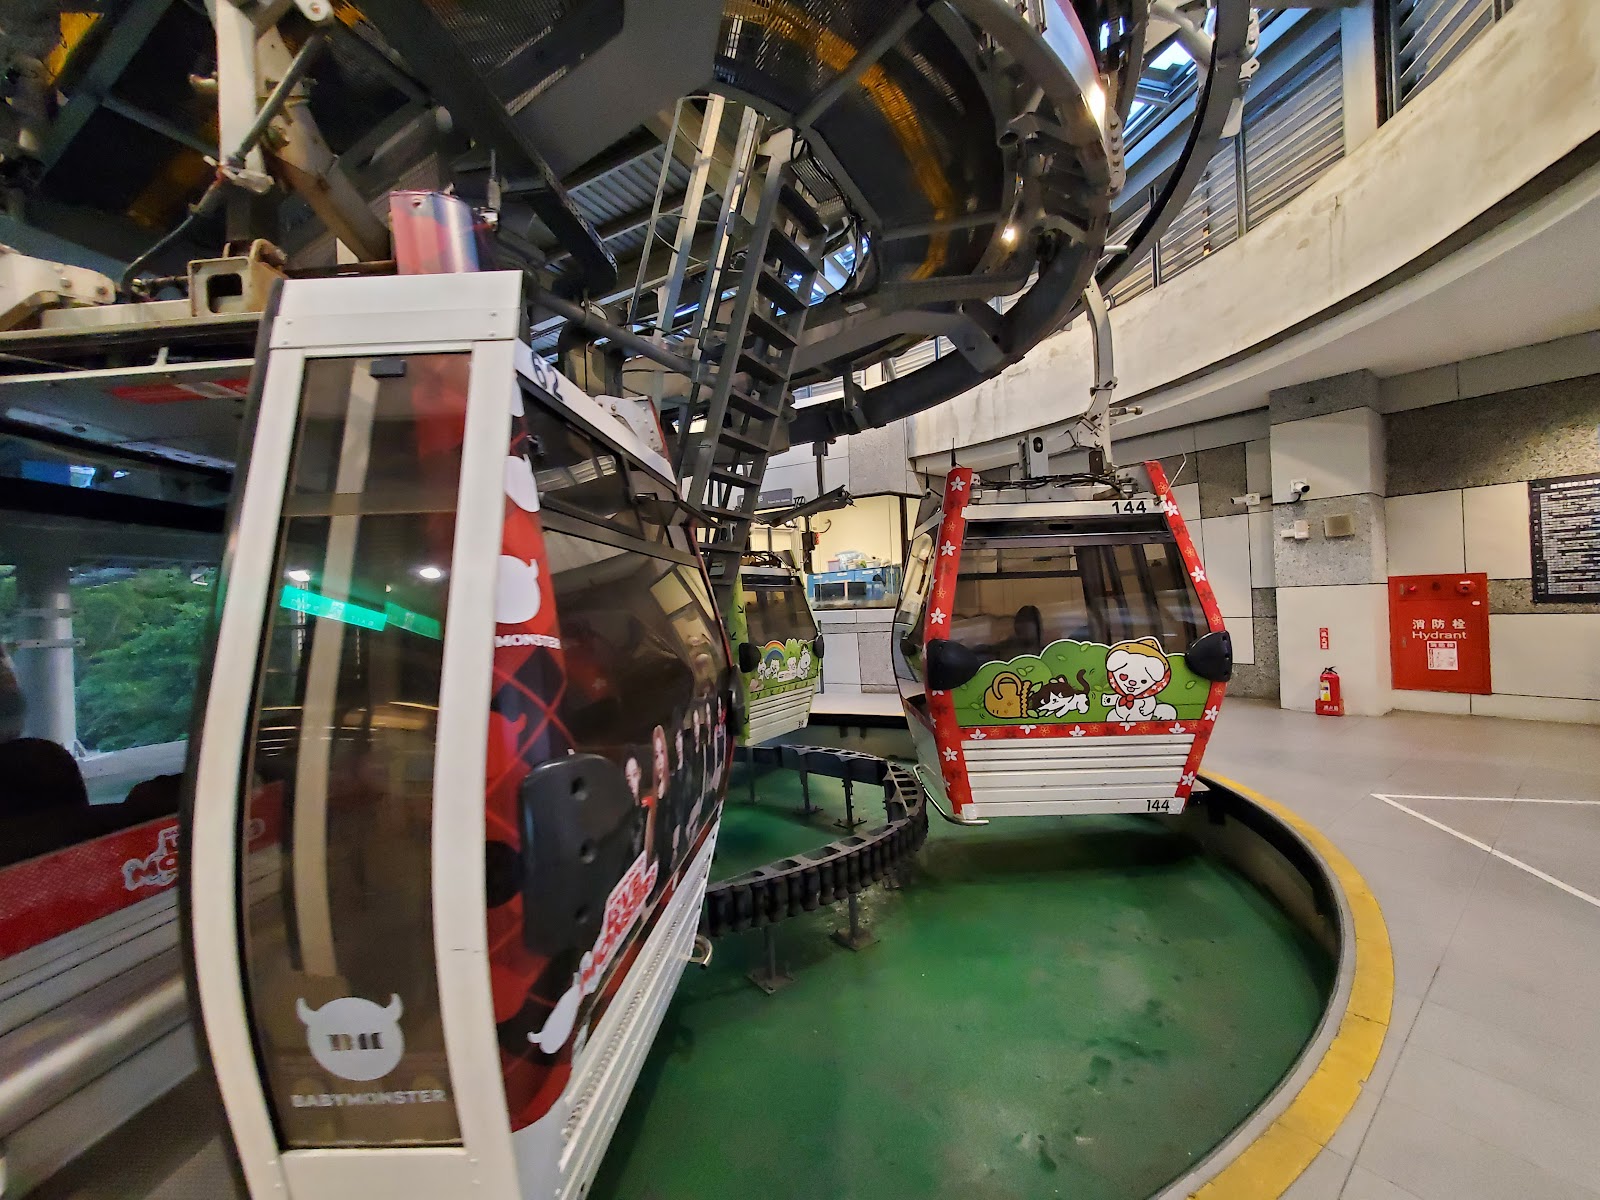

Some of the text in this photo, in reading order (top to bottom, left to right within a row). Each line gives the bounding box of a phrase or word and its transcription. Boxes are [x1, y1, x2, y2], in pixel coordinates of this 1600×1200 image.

[1112, 500, 1147, 513] 144
[1412, 618, 1466, 630] 消防栓
[1412, 631, 1467, 641] Hydrant
[1146, 799, 1170, 811] 144
[290, 1089, 447, 1109] BABYMONSTER
